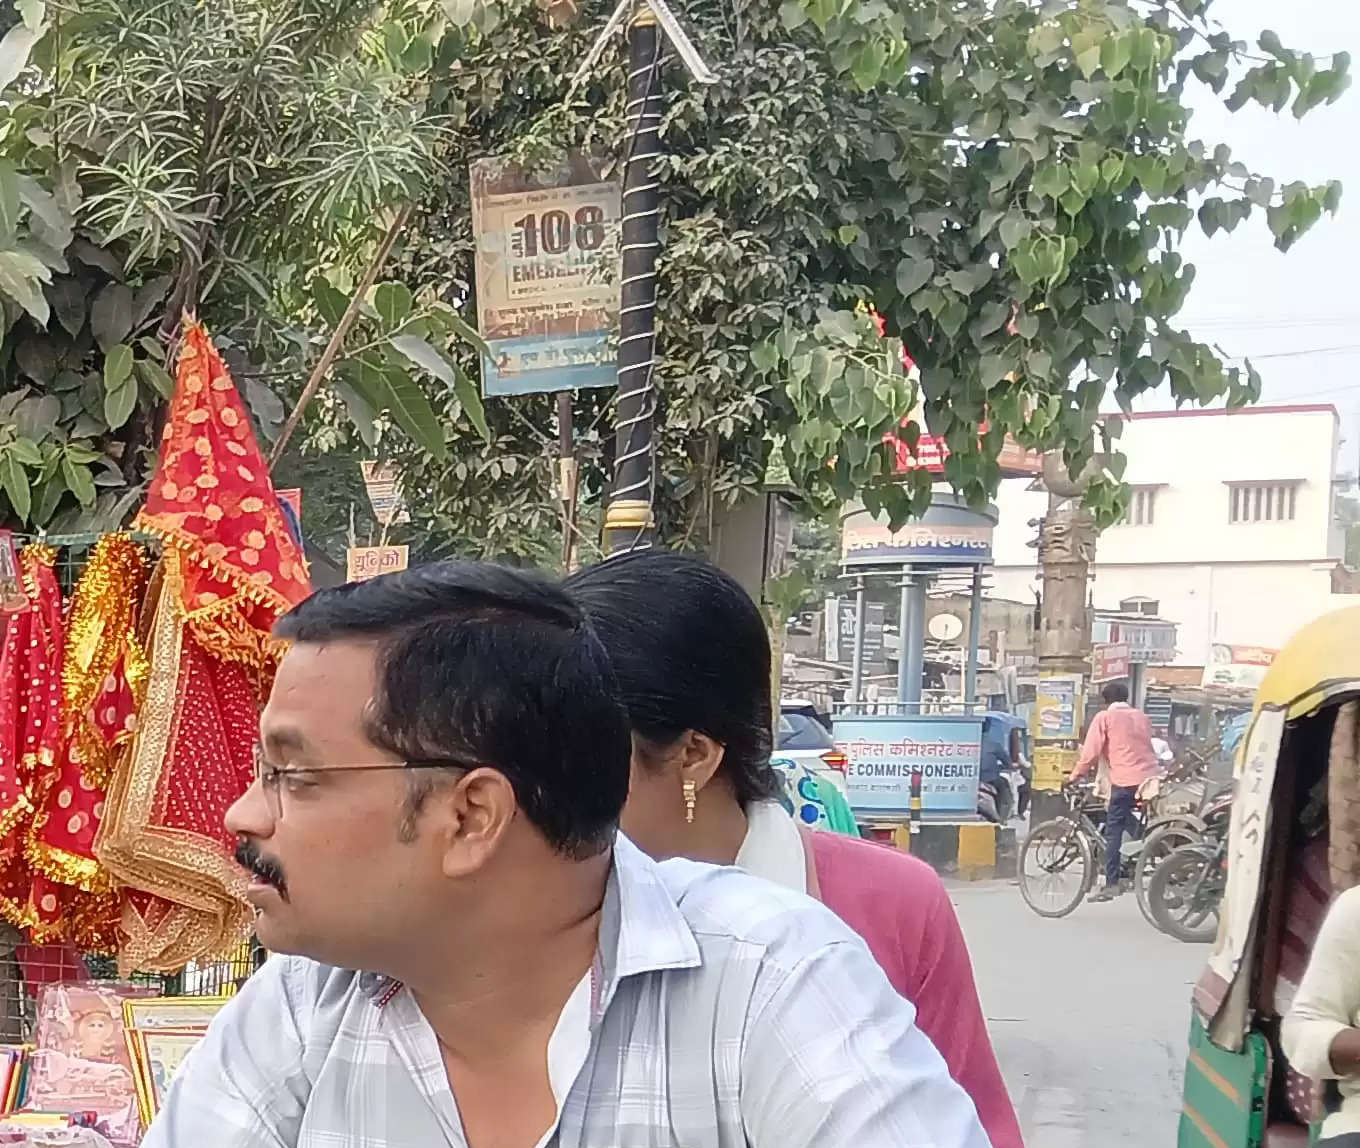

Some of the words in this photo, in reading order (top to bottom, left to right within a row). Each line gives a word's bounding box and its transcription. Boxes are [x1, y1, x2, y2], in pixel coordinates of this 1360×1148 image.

[514, 205, 606, 258] 108
[851, 737, 885, 761] पुलिस
[857, 763, 973, 778] COMMISSIONERATE
